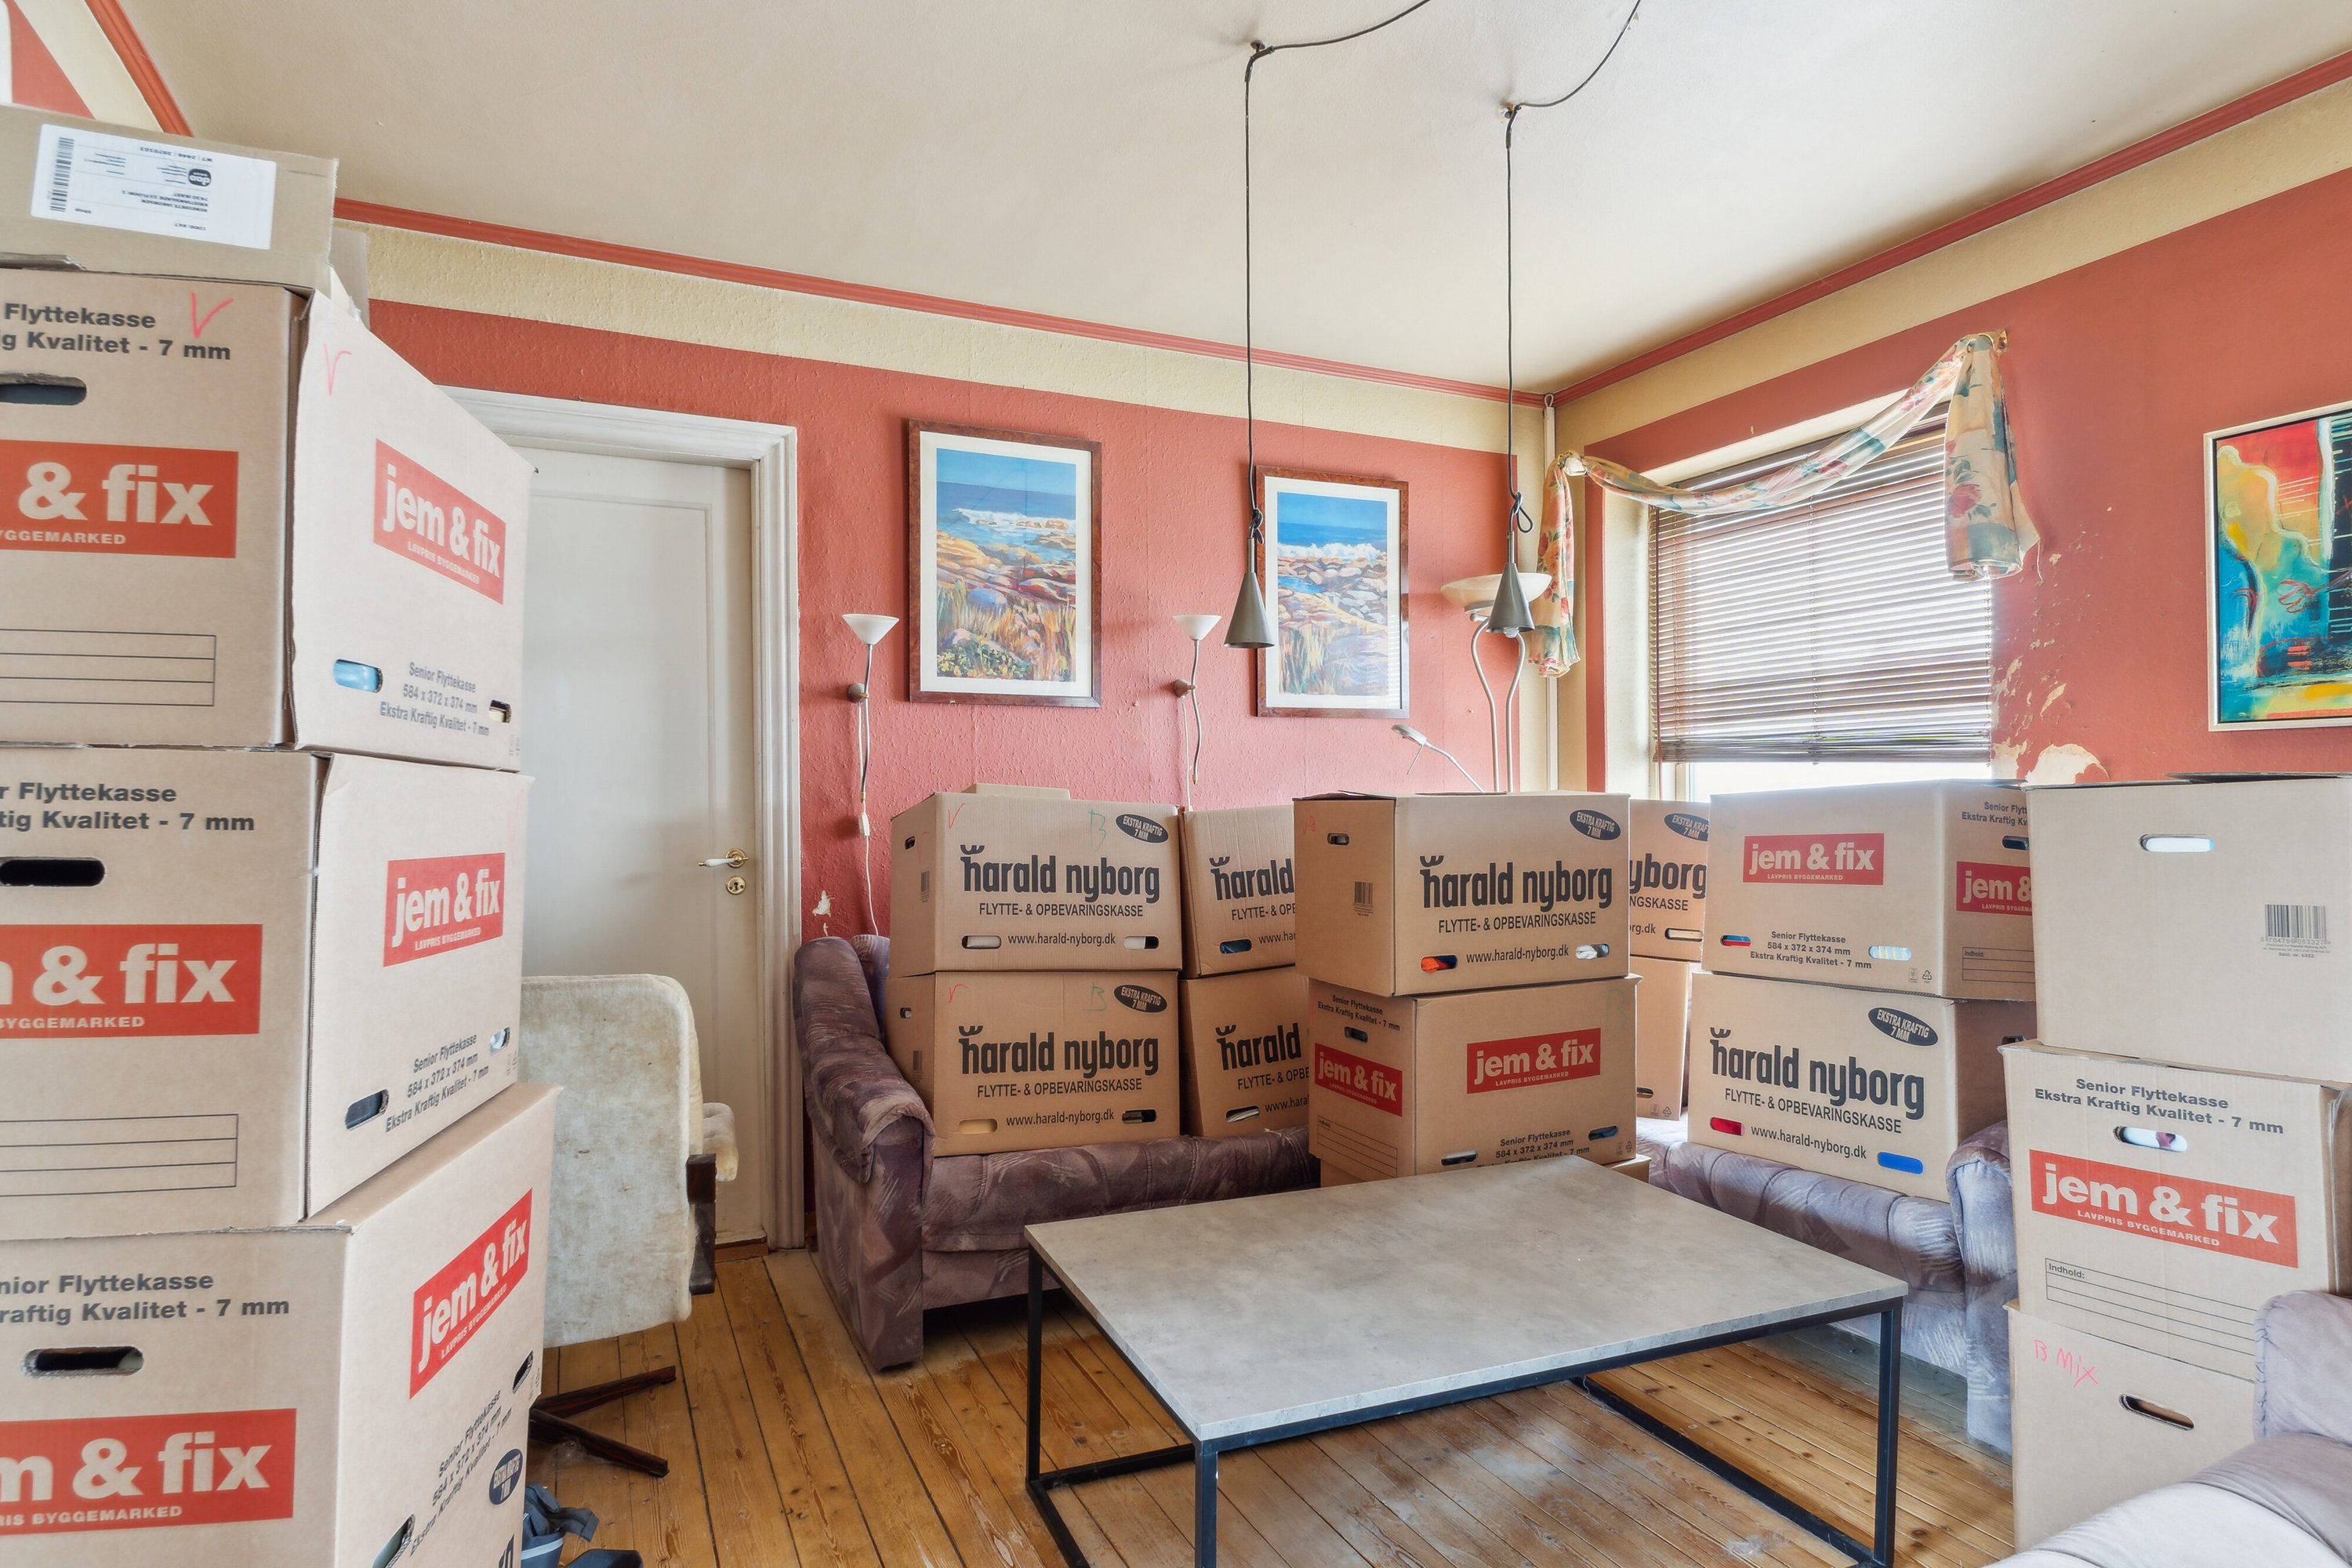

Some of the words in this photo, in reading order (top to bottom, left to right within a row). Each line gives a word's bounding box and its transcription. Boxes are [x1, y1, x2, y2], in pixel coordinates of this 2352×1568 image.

[4, 303, 156, 328] Flyttekasse
[27, 331, 129, 354] Kvalitet
[158, 339, 173, 356] 7
[183, 343, 230, 361] mm
[18, 462, 89, 521] &
[102, 463, 214, 526] fix
[383, 463, 445, 547] jem
[450, 506, 470, 561] &
[473, 518, 501, 579] fix
[409, 661, 435, 681] Senior
[437, 670, 476, 694] Flyttekasse
[403, 683, 419, 699] 584
[427, 690, 443, 706] 372
[379, 701, 408, 721] Ekstra
[411, 708, 437, 729] Kraftig
[19, 782, 177, 804] Flyttekasse
[1962, 811, 1987, 822] Ekstra
[1990, 815, 2016, 826] Kraftig
[1984, 801, 2009, 812] Senior
[42, 811, 151, 829] Kvalitet
[180, 812, 194, 830] 7
[205, 817, 256, 831] mm
[1123, 815, 1142, 829] EKSTRA
[1142, 822, 1163, 837] KRAFTIG
[1576, 812, 1595, 826] EKSTRA
[1595, 817, 1615, 833] KRAFTIG
[1671, 815, 1693, 828] EKSTRA
[1749, 844, 1801, 875] jem
[1806, 843, 1830, 870] &
[1835, 842, 1875, 870] fix
[960, 855, 1057, 893] harald
[1066, 858, 1160, 903] nyborg
[1210, 858, 1295, 901] harald
[1420, 862, 1513, 909] harald
[1523, 861, 1612, 913] nyborg
[1629, 853, 1706, 900] yborg
[1963, 870, 2013, 904] jem
[392, 877, 450, 948] jem
[453, 872, 473, 923] &
[475, 868, 501, 917] fix
[979, 903, 1022, 916] FLYTTE-
[1025, 903, 1033, 916] &
[1036, 903, 1143, 917] OPBEVARINGSKASSE
[1231, 907, 1269, 920] FLYTTE-
[1271, 905, 1277, 916] &
[1629, 895, 1689, 911] NGSKASSE
[1438, 919, 1481, 933] FLYTTE-
[1483, 918, 1490, 931] &
[1493, 911, 1596, 931] OPBEVARINGSKASSE
[1007, 932, 1116, 947] www.harald-nyborg.dk
[1772, 931, 1796, 940] Senior
[1798, 933, 1846, 944] Flyttekasse
[1466, 944, 1569, 964] www.harald-nyborg.dk
[1777, 953, 1803, 964] Kraftig
[1806, 956, 1838, 966] Kvalitet
[32, 946, 106, 1006] &
[119, 943, 238, 1004] fix
[1121, 986, 1141, 1002] EKSTRA
[1140, 991, 1161, 1006] KRAFTIG
[1333, 995, 1349, 1005] Senior
[1350, 1000, 1383, 1014] Flyttekasse
[1318, 1002, 1334, 1013] Ekstra
[1336, 1007, 1353, 1019] Kraftig
[1355, 1012, 1377, 1024] Kvalitet
[1877, 1010, 1900, 1027] EKSTRA
[1901, 1018, 1929, 1038] KRAFTIG
[414, 1054, 439, 1074] Senior
[439, 1035, 477, 1061] Flyttekasse
[958, 1032, 1054, 1074] harald
[1065, 1031, 1159, 1079] nyborg
[1217, 1022, 1302, 1071] harald
[1474, 1051, 1530, 1085] jem
[1535, 1043, 1557, 1071] &
[1561, 1039, 1594, 1066] fix
[431, 1069, 445, 1087] 372
[977, 1083, 1021, 1098] FLYTTE-
[1024, 1083, 1032, 1096] &
[1033, 1077, 1142, 1095] OPBEVARINGSKASSE
[1237, 1074, 1276, 1090] FLYTTE-
[1277, 1072, 1284, 1083] &
[1318, 1051, 1351, 1085] jem
[1354, 1065, 1369, 1092] &
[1371, 1070, 1397, 1102] fix
[1496, 1078, 1522, 1087] LAVPRIS
[1710, 1040, 1800, 1090] harald
[1809, 1056, 1925, 1120] nyborg
[2076, 1078, 2126, 1096] Senior
[2131, 1085, 2228, 1109] Flyttekasse
[386, 1109, 412, 1133] Ekstra
[414, 1091, 441, 1116] Kraftig
[1006, 1108, 1115, 1127] www.harald-nyborg.dk
[1725, 1087, 1765, 1107] FLYTTE-
[1767, 1096, 1775, 1110] &
[1778, 1098, 1902, 1134] OPBEVARINGSKASSE
[2034, 1088, 2082, 1105] Ekstra
[2087, 1095, 2140, 1116] Kraftig
[2146, 1104, 2212, 1124] Kvalitet
[2231, 1116, 2242, 1128] 7
[2249, 1121, 2283, 1134] mm
[1496, 1150, 1511, 1159] 584
[1520, 1145, 1535, 1154] 372
[1544, 1141, 1558, 1149] 374
[1560, 1138, 1574, 1147] mm
[1501, 1137, 1526, 1148] Senior
[1528, 1129, 1571, 1143] Flyttekasse
[1751, 1124, 1867, 1160] www.harald-nyborg.dk
[2042, 1162, 2138, 1216] jem
[2149, 1185, 2194, 1227] &
[2201, 1193, 2280, 1245] fix
[2078, 1210, 2123, 1226] LAVPRIS
[2127, 1221, 2220, 1247] BYGGEMARKED
[2049, 1262, 2085, 1279] Indhold:
[58, 1273, 214, 1297] Flyttekasse
[418, 1272, 477, 1374] jem
[481, 1242, 499, 1298] &
[502, 1218, 527, 1277] fix
[82, 1300, 187, 1322] Kvalitet
[216, 1298, 232, 1317] 7
[241, 1301, 290, 1316] mm
[72, 1438, 144, 1501] &
[157, 1431, 273, 1494] fix
[31, 1505, 183, 1526] BYGGEMARKED
